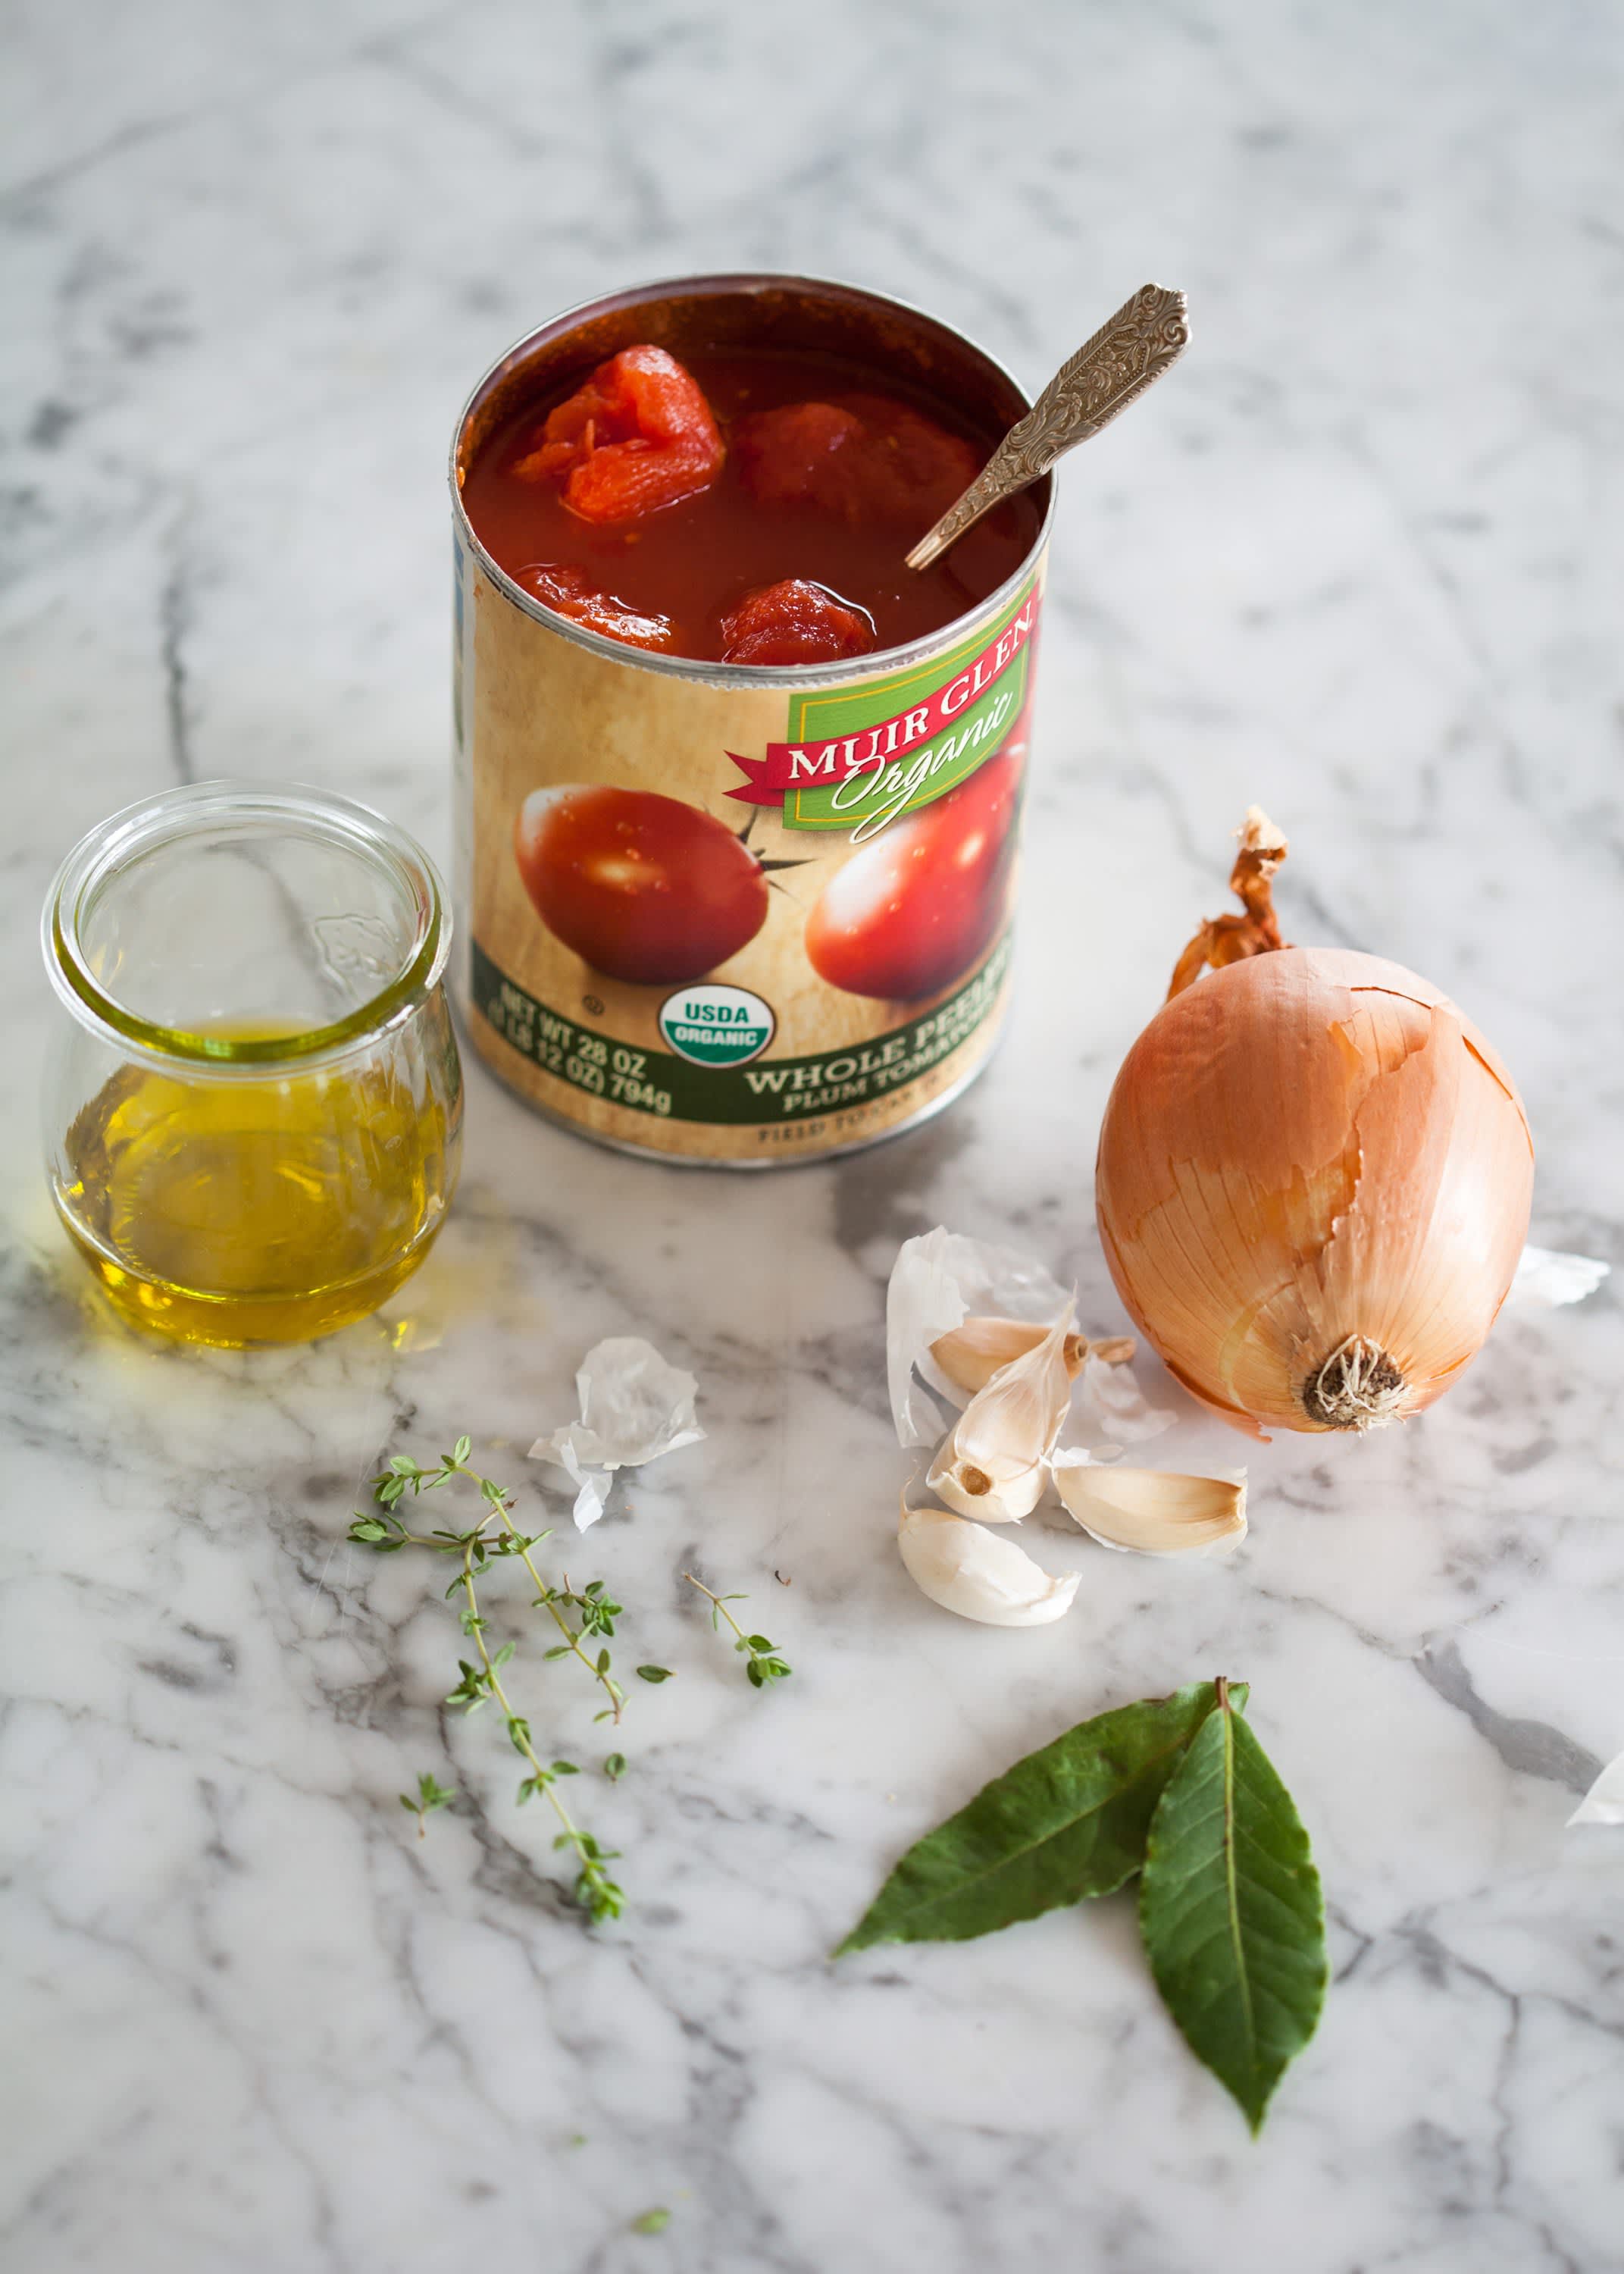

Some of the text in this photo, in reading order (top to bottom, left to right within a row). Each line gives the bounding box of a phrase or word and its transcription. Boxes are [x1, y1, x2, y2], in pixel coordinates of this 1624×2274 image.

[787, 600, 1033, 781] MUIR GLEN
[831, 691, 1013, 845] Organic
[500, 982, 646, 1079] NET WT 28 OZ
[674, 1026, 759, 1047] ORGANIC
[685, 1003, 749, 1023] USDA
[743, 934, 1012, 1094] WHOLE PEEL
[781, 1077, 867, 1113] PLUM
[873, 985, 997, 1087] TOMATO
[537, 1038, 562, 1072] 12
[566, 1055, 605, 1095] OZ)
[609, 1073, 672, 1116] 794g
[759, 1114, 826, 1143] FIELD
